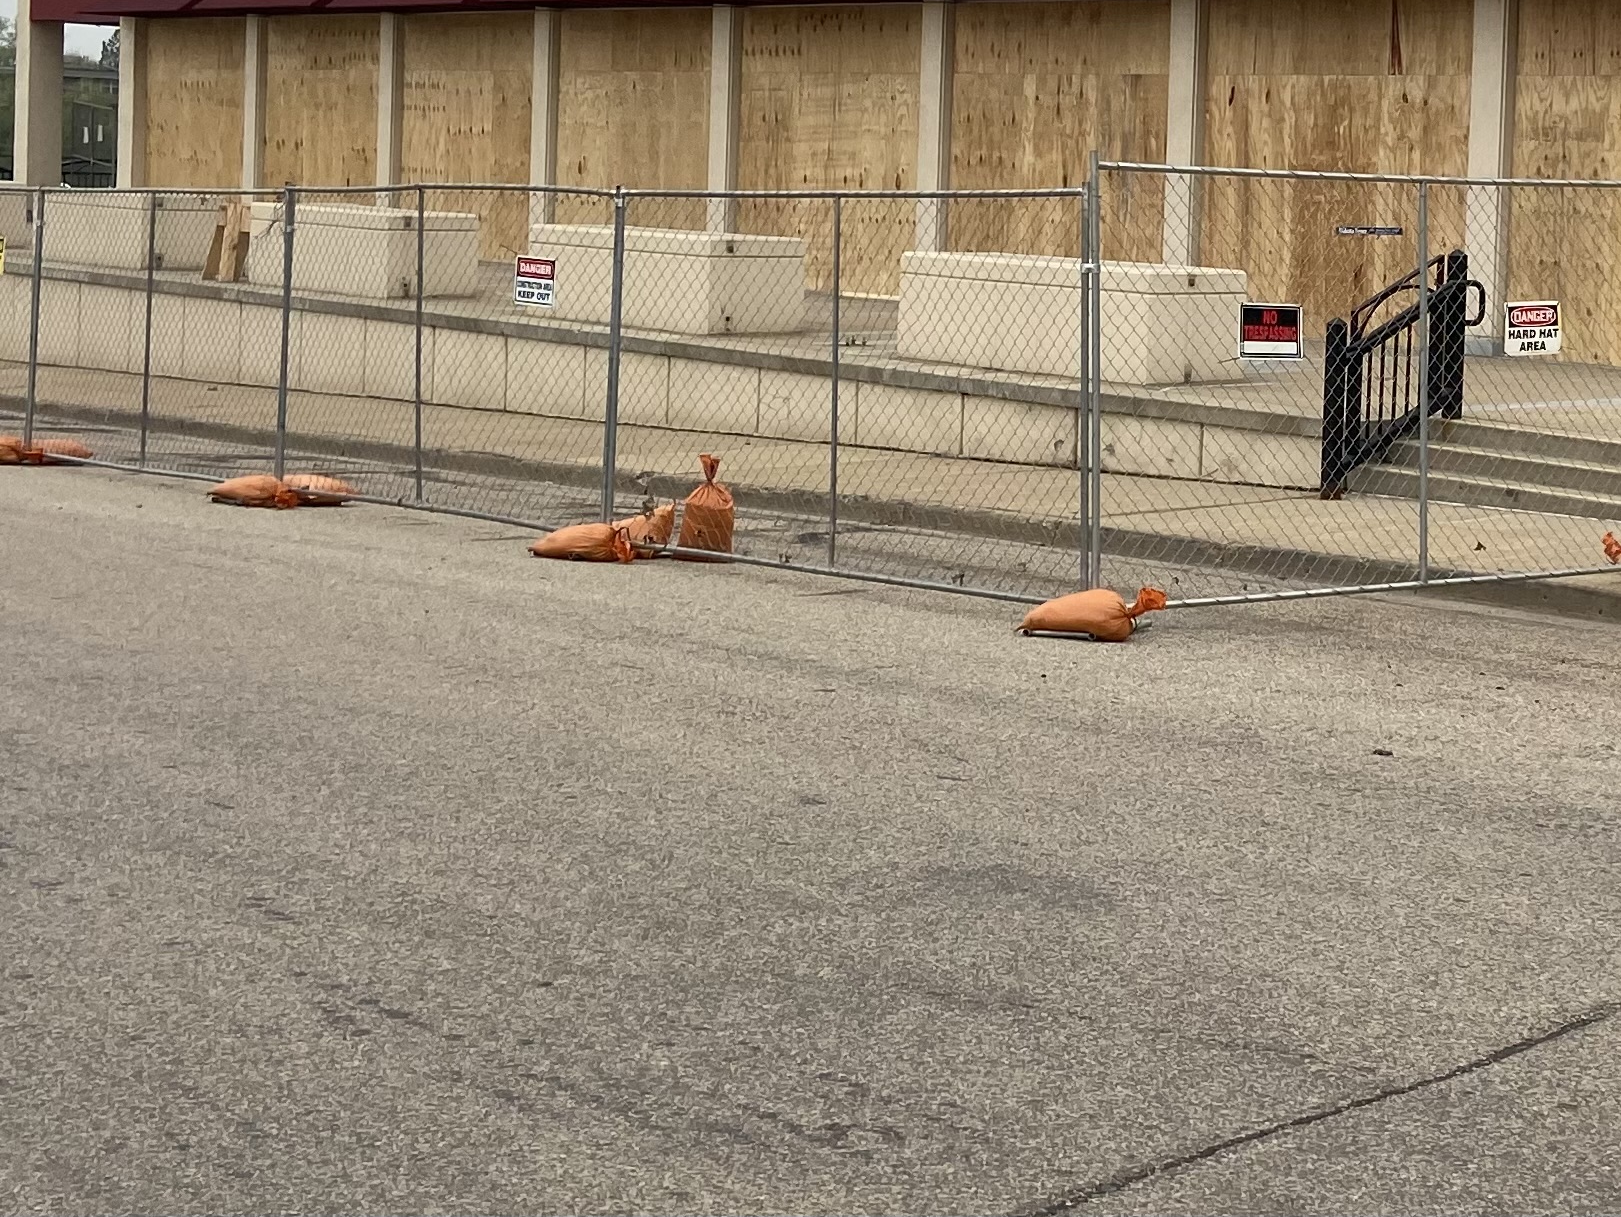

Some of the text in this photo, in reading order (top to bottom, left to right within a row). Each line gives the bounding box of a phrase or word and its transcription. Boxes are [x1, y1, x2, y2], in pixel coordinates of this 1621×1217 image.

[520, 262, 552, 275] DANGER
[518, 290, 550, 301] KEEP OUT
[1263, 310, 1278, 324] NO
[1513, 310, 1553, 322] DANGER
[1244, 325, 1297, 341] TRESPASSING
[1508, 328, 1559, 339] HARD HAT
[1520, 341, 1546, 352] AREA
